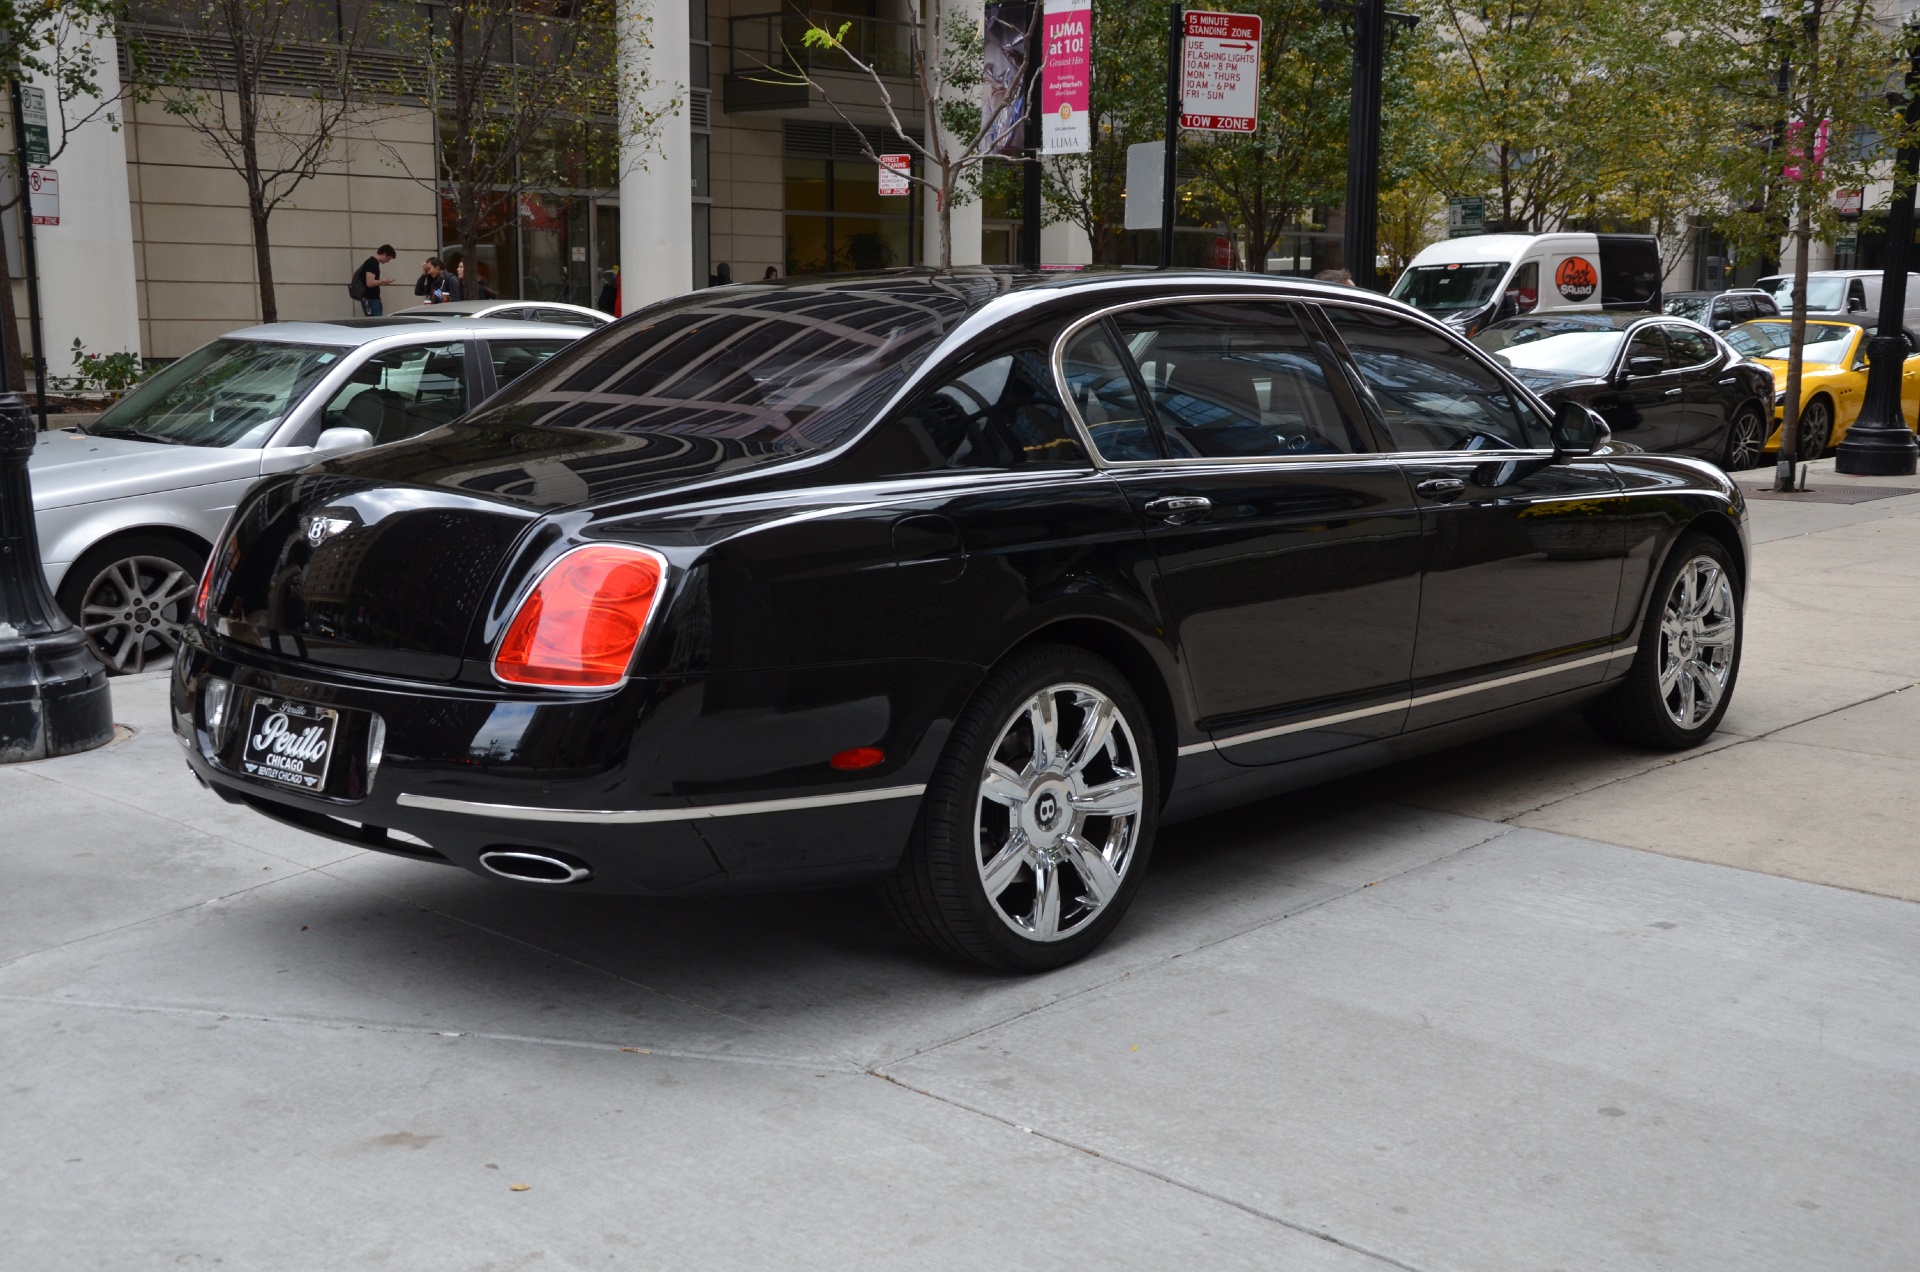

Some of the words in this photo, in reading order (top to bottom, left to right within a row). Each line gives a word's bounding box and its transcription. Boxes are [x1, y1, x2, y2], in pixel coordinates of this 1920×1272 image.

[1190, 15, 1198, 24] 15
[1200, 16, 1229, 26] MINUTE
[1050, 21, 1084, 38] LUMA
[1189, 25, 1228, 36] STANDING
[1231, 28, 1252, 38] ZONE
[1050, 41, 1062, 55] at
[1065, 38, 1084, 54] 10!
[1188, 41, 1204, 50] USE
[1050, 58, 1070, 67] Greatest
[1072, 56, 1084, 65] Hits
[1188, 51, 1226, 62] FLASHING
[1228, 54, 1254, 63] LIGHTS
[1226, 63, 1237, 71] PM
[1187, 70, 1204, 79] MON
[1214, 72, 1240, 81] THURS
[1186, 90, 1199, 98] FRI
[1207, 91, 1224, 100] SUN
[1186, 115, 1211, 128] TOW
[1217, 117, 1249, 130] ZONE
[1052, 137, 1079, 148] LUMA
[1562, 258, 1590, 286] Geek
[1561, 284, 1592, 295] Squad
[279, 702, 307, 716] Perillo
[252, 712, 327, 763] Perillo
[266, 754, 304, 772] CHICAGO
[257, 766, 278, 778] BENTLEY
[278, 770, 302, 784] CHICAGO
